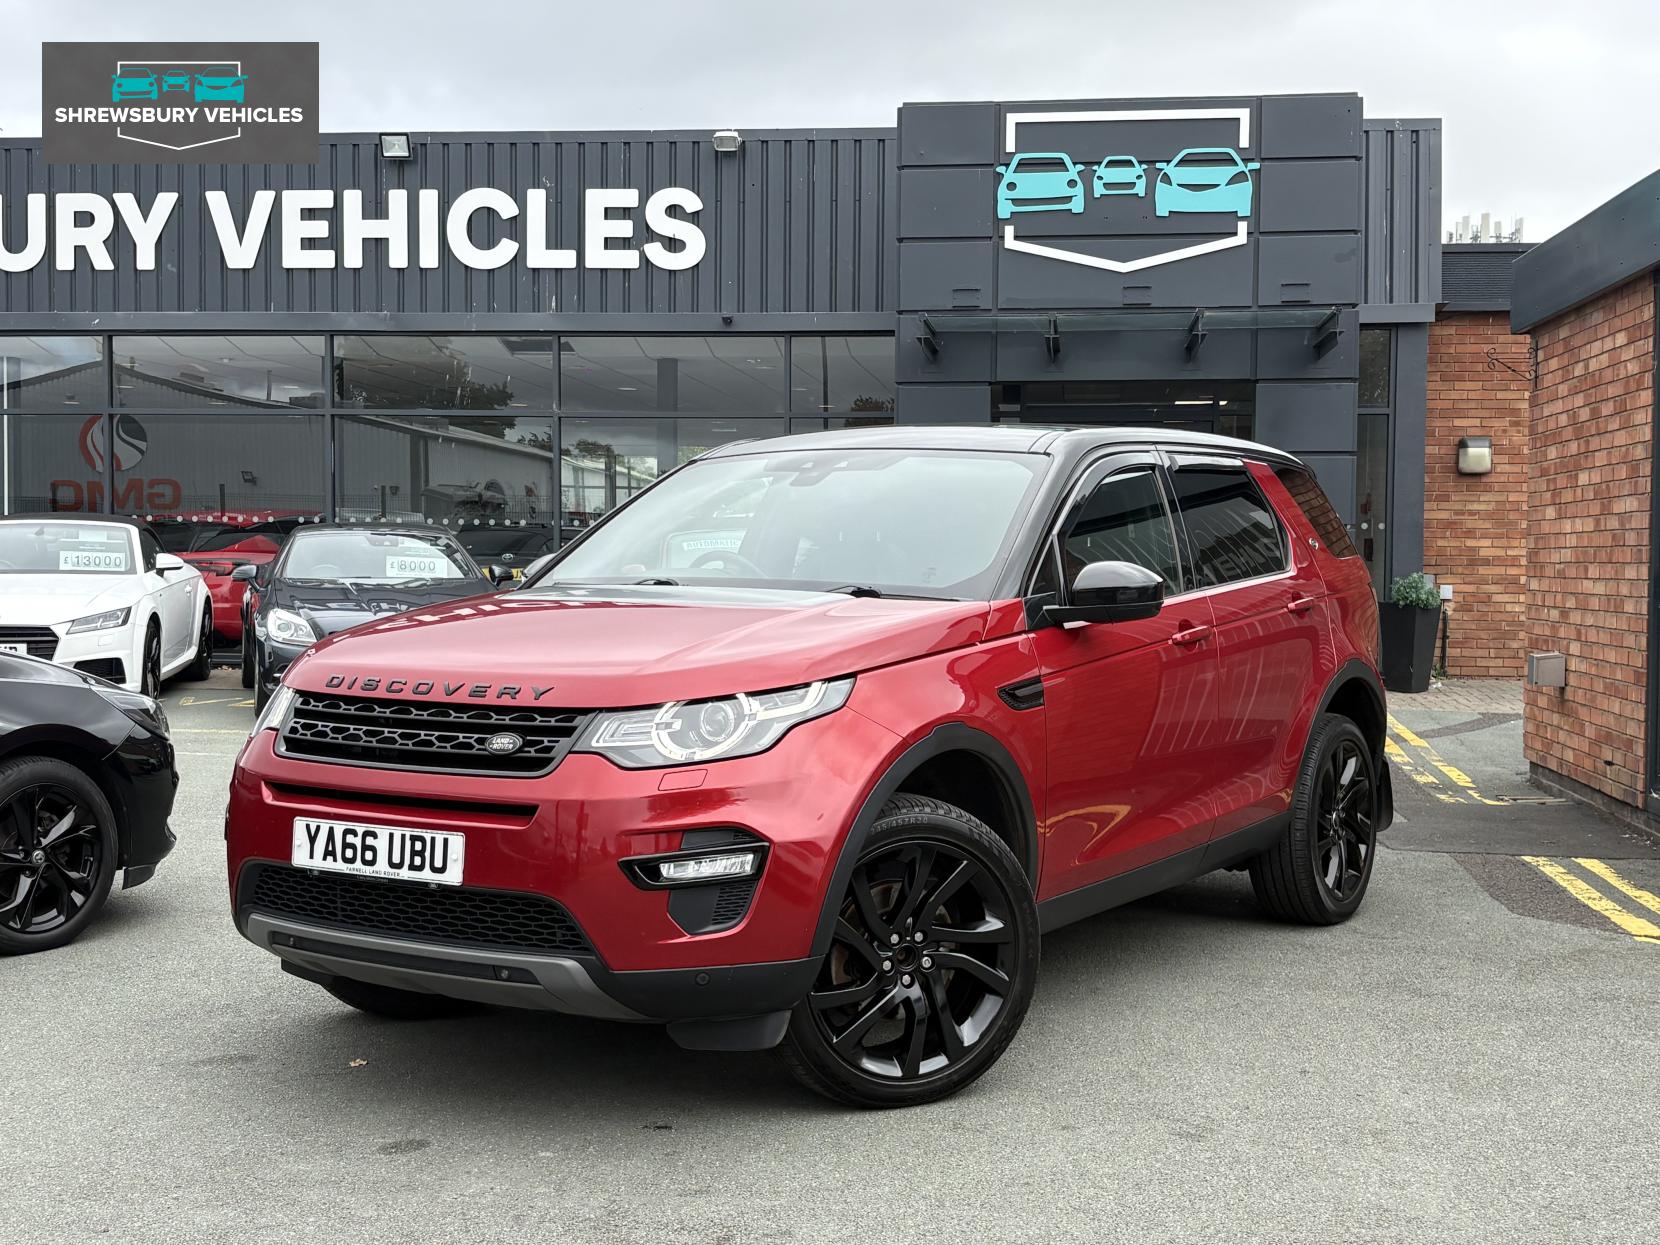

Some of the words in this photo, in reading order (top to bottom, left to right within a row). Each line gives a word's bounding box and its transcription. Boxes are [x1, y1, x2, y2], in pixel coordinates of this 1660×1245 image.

[0, 192, 179, 273] URY
[205, 187, 707, 271] VEHICLES
[325, 674, 555, 700] DISCOVERY
[305, 823, 379, 867] YA66
[387, 832, 449, 875] UBU
